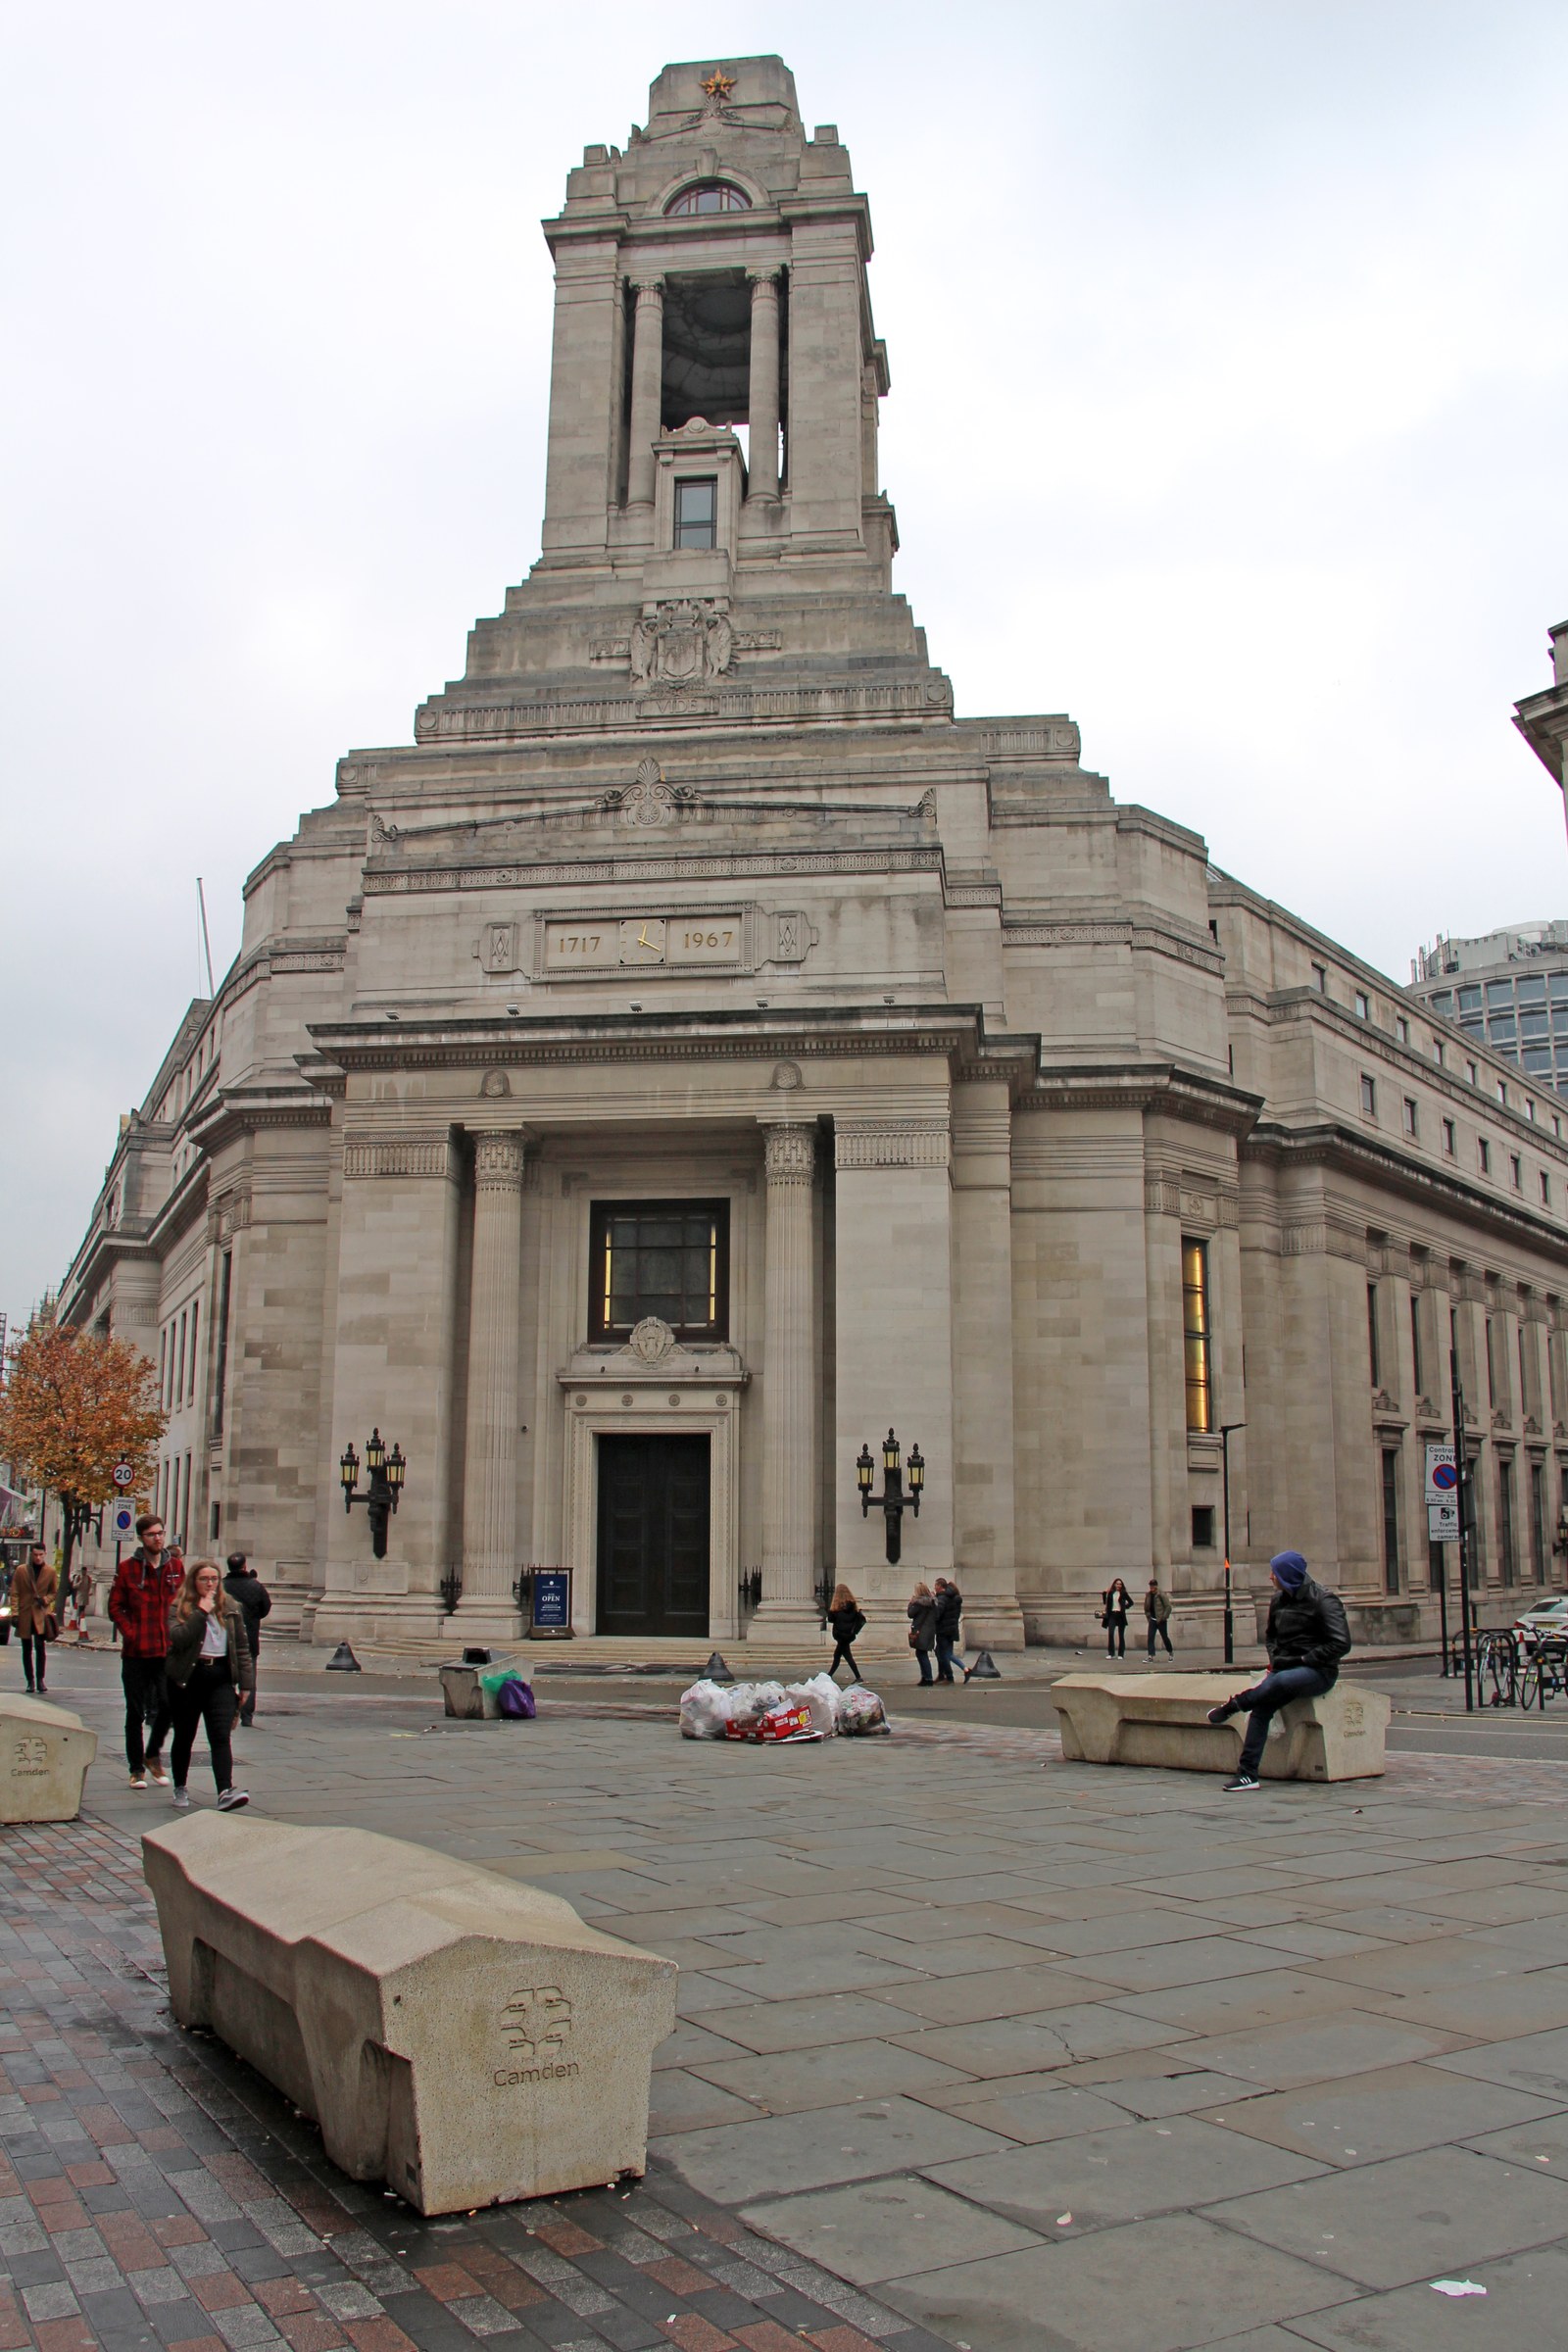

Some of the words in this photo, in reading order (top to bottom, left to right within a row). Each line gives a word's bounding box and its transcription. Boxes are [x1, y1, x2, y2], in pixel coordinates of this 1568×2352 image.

[740, 632, 774, 647] TACE
[656, 699, 698, 713] VIDE
[560, 936, 602, 954] 1717
[684, 931, 733, 950] 1967
[115, 1469, 131, 1480] 20
[11, 1768, 51, 1777] Camden
[493, 2062, 579, 2087] Camden
